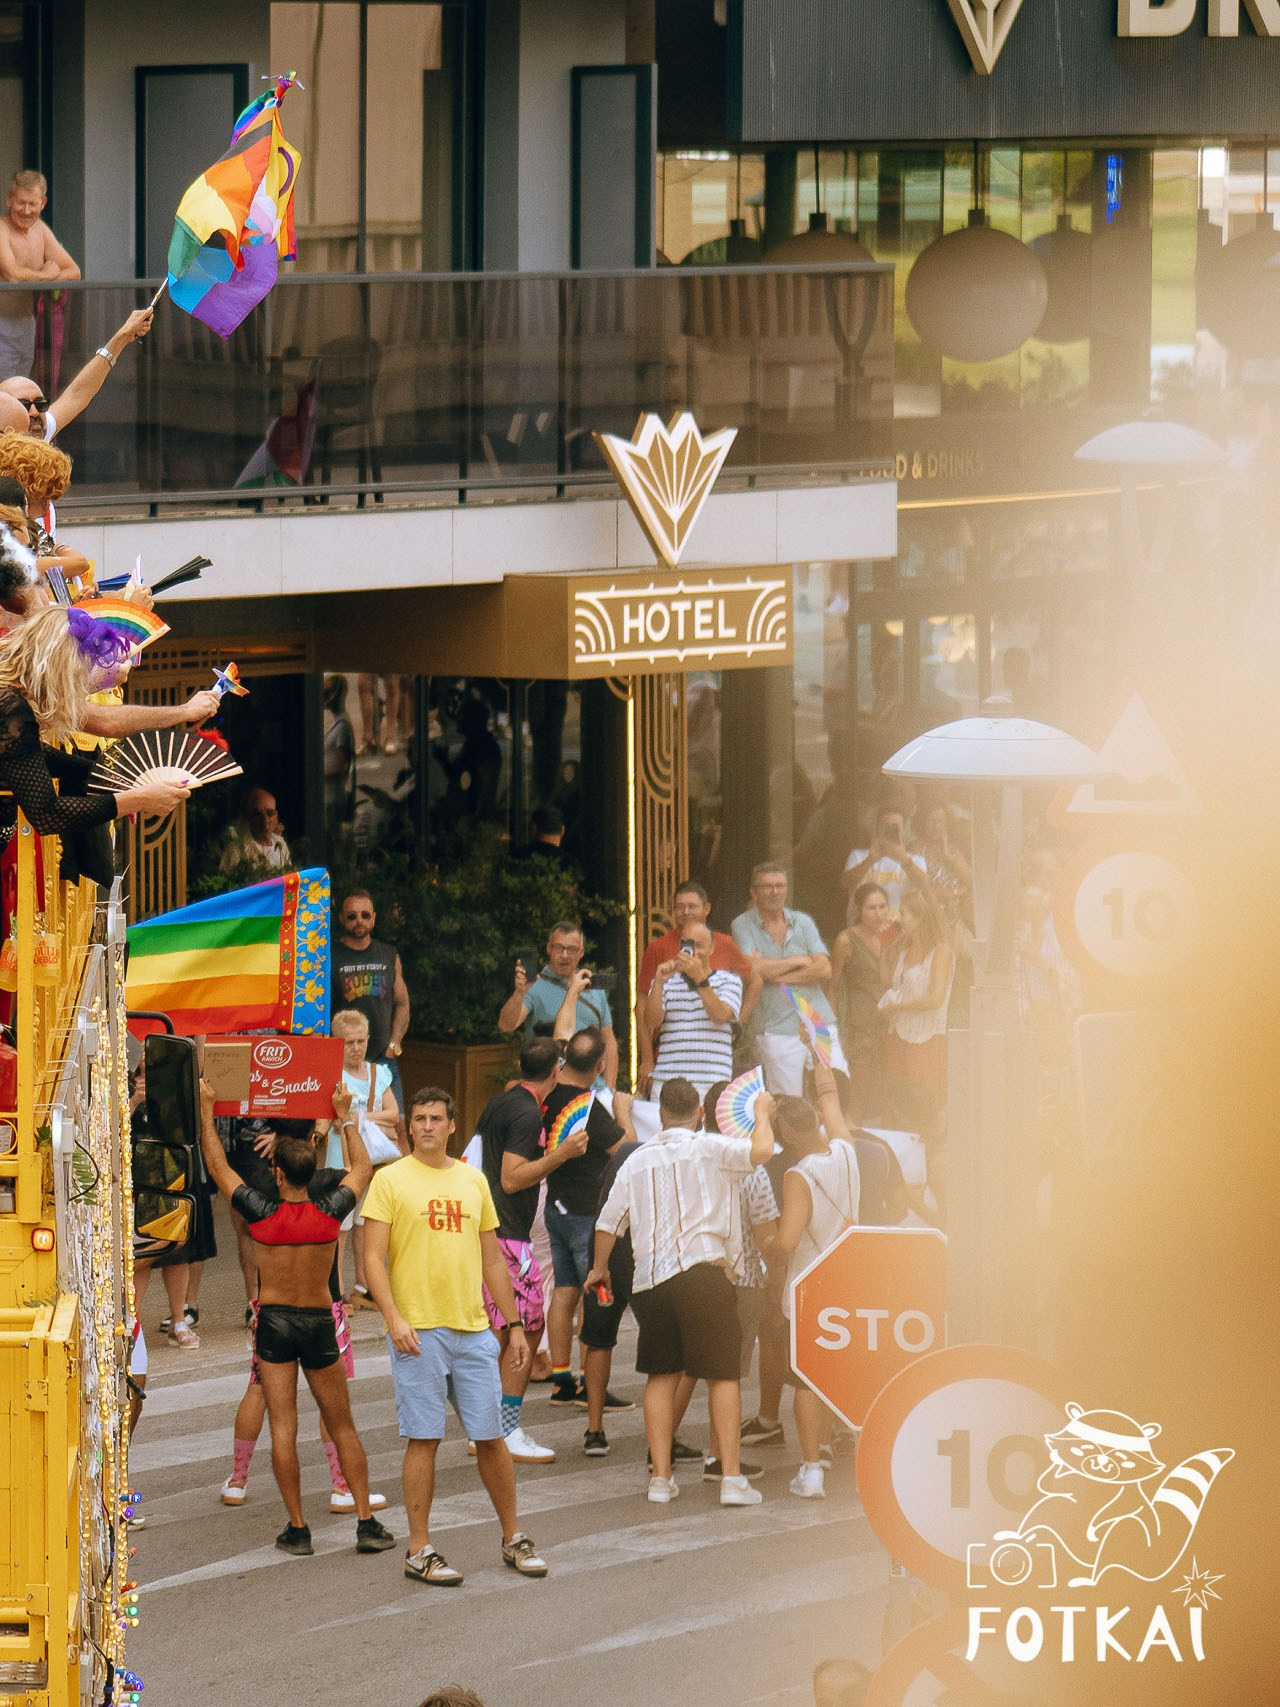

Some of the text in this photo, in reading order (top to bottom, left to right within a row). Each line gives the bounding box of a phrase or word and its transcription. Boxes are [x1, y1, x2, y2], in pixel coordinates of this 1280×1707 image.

[623, 599, 737, 645] HOTEL
[1102, 888, 1179, 942] 10
[259, 1045, 288, 1057] FRIT
[261, 1078, 269, 1088] &
[269, 1076, 321, 1096] Snacks
[814, 1306, 949, 1353] STO
[936, 1429, 1052, 1516] 10
